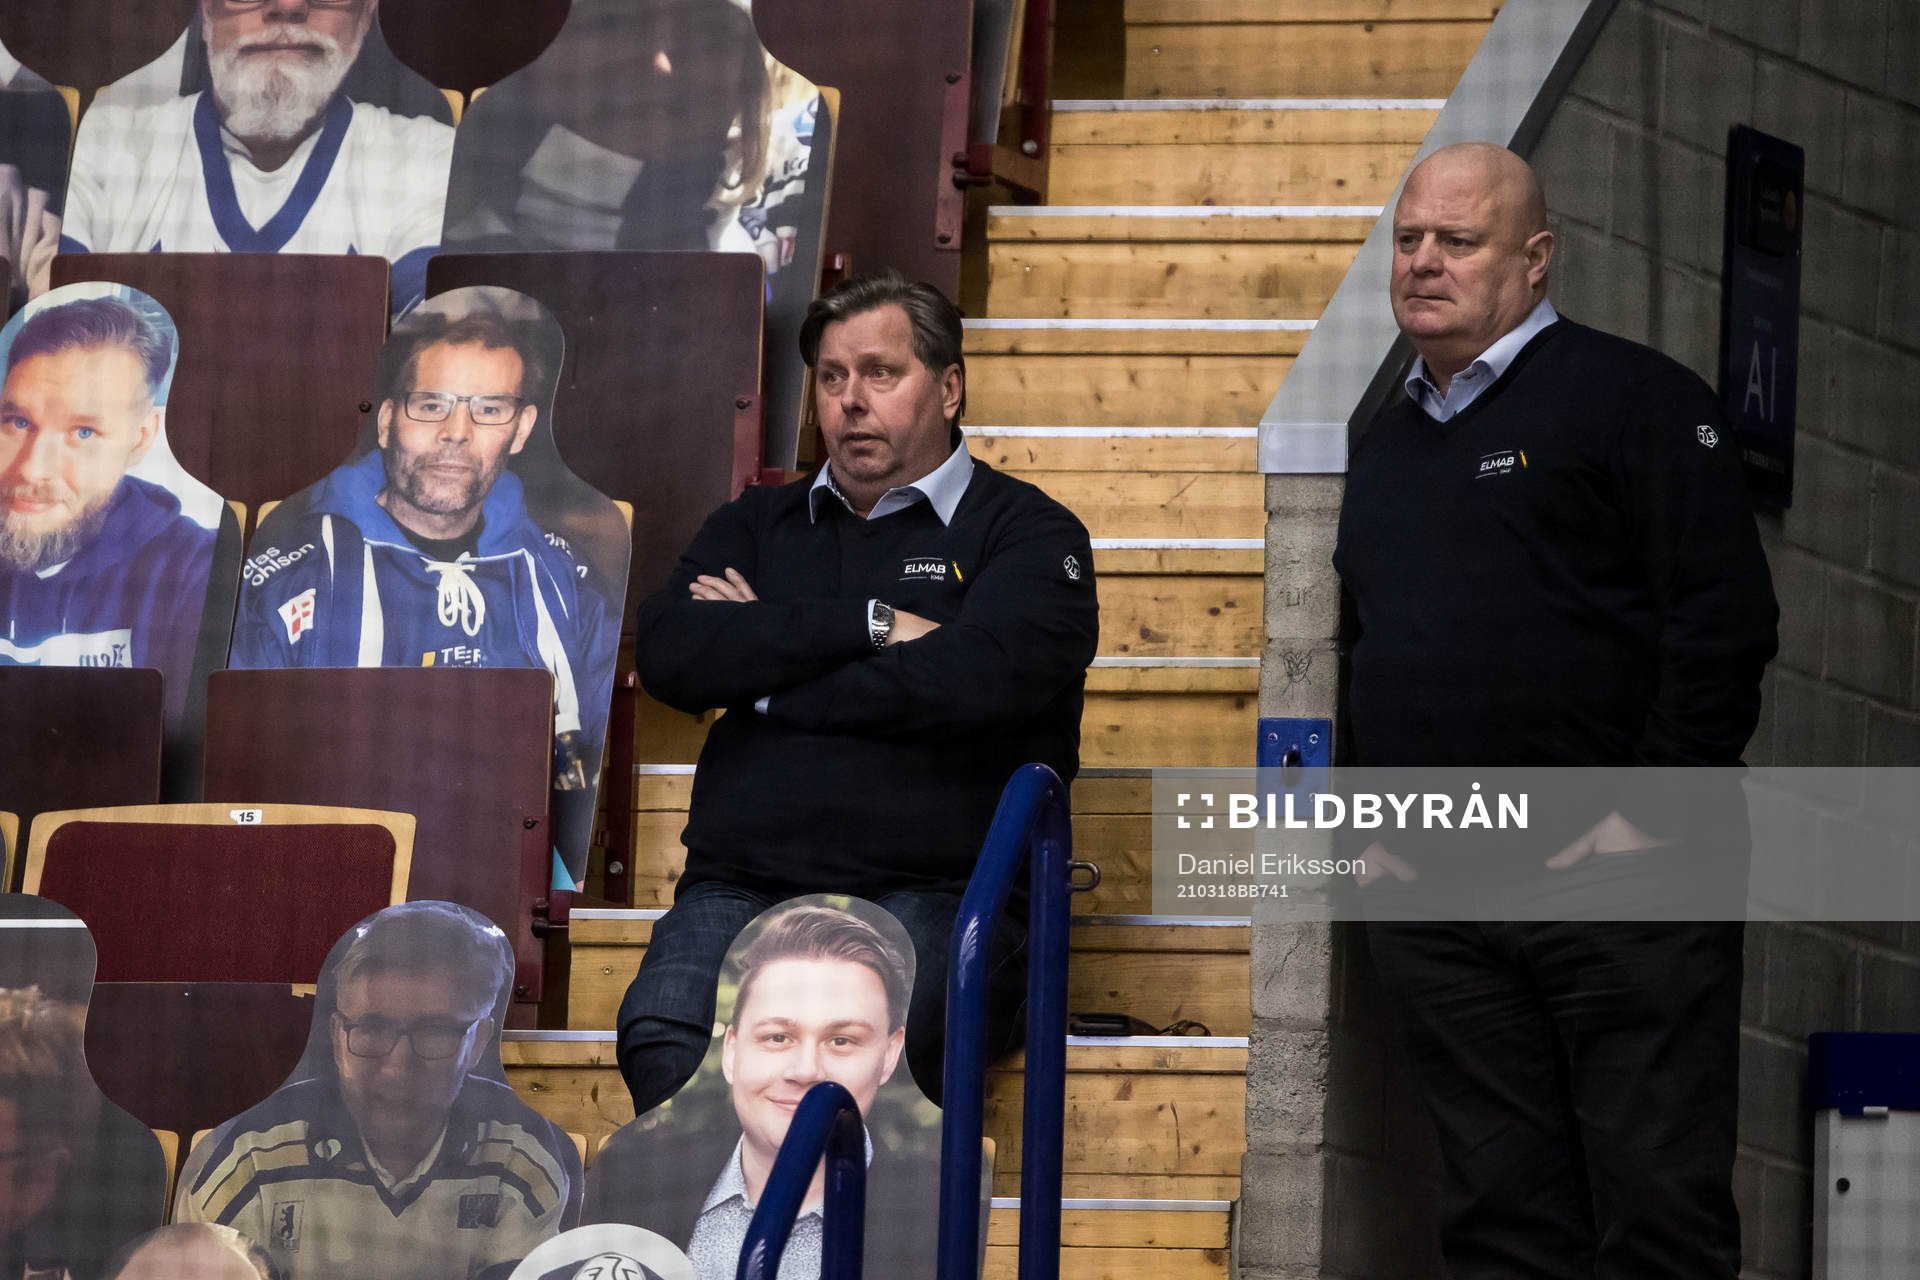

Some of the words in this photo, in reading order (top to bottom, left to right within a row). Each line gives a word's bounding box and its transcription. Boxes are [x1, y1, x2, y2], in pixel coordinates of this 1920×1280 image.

[1480, 456, 1514, 471] ELMAB
[243, 547, 280, 579] clas
[252, 544, 315, 586] ohlson
[905, 563, 946, 573] ELMAB
[239, 812, 254, 822] 15
